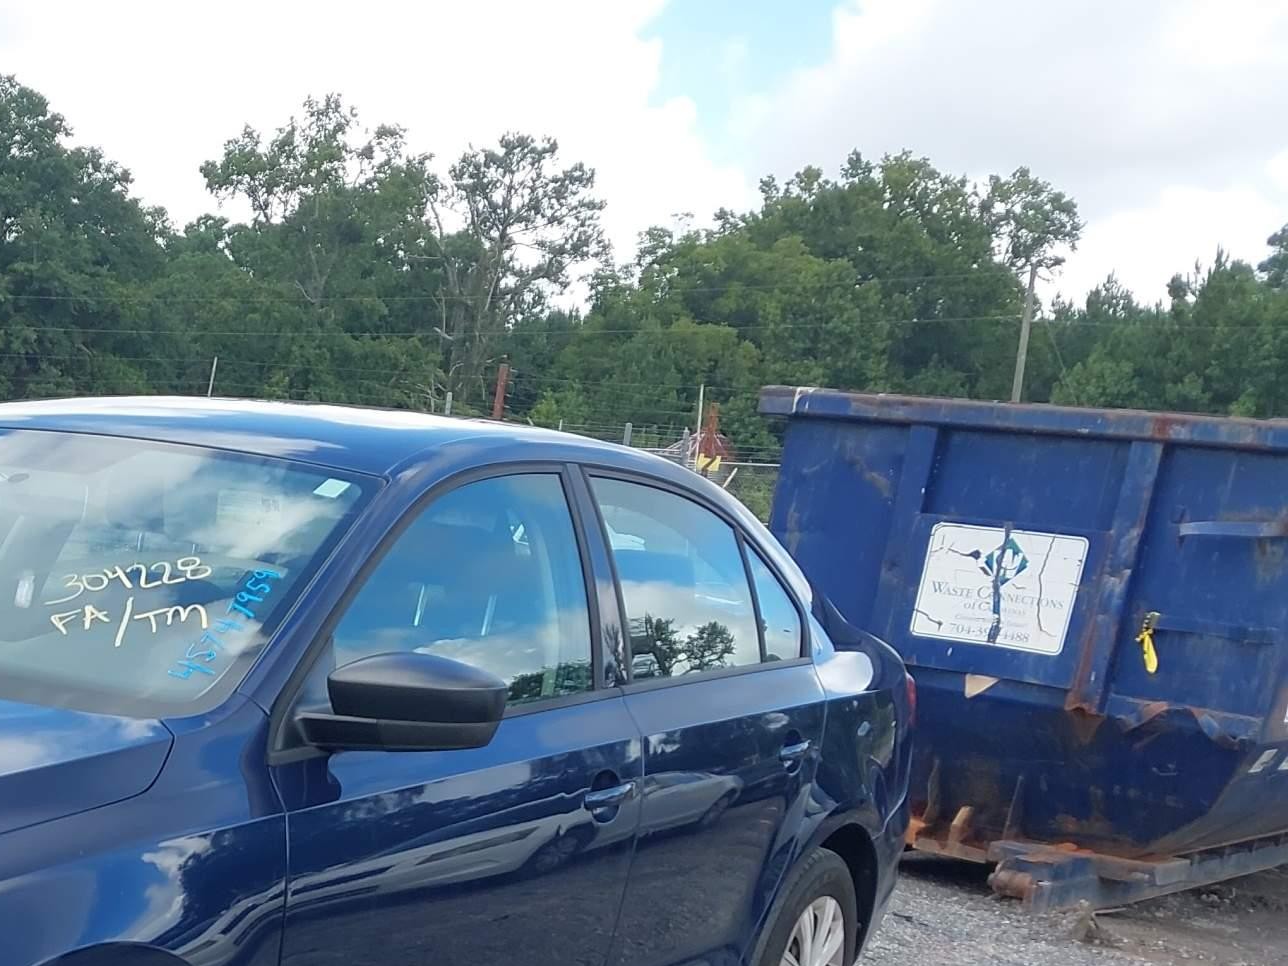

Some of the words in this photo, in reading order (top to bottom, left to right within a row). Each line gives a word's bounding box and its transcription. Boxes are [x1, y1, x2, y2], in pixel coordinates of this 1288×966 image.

[44, 556, 212, 605] 304228
[932, 580, 974, 599] WASTE
[977, 585, 1064, 609] CNECTONS
[167, 567, 281, 679] 45747959
[950, 623, 1029, 642] 704-34488
